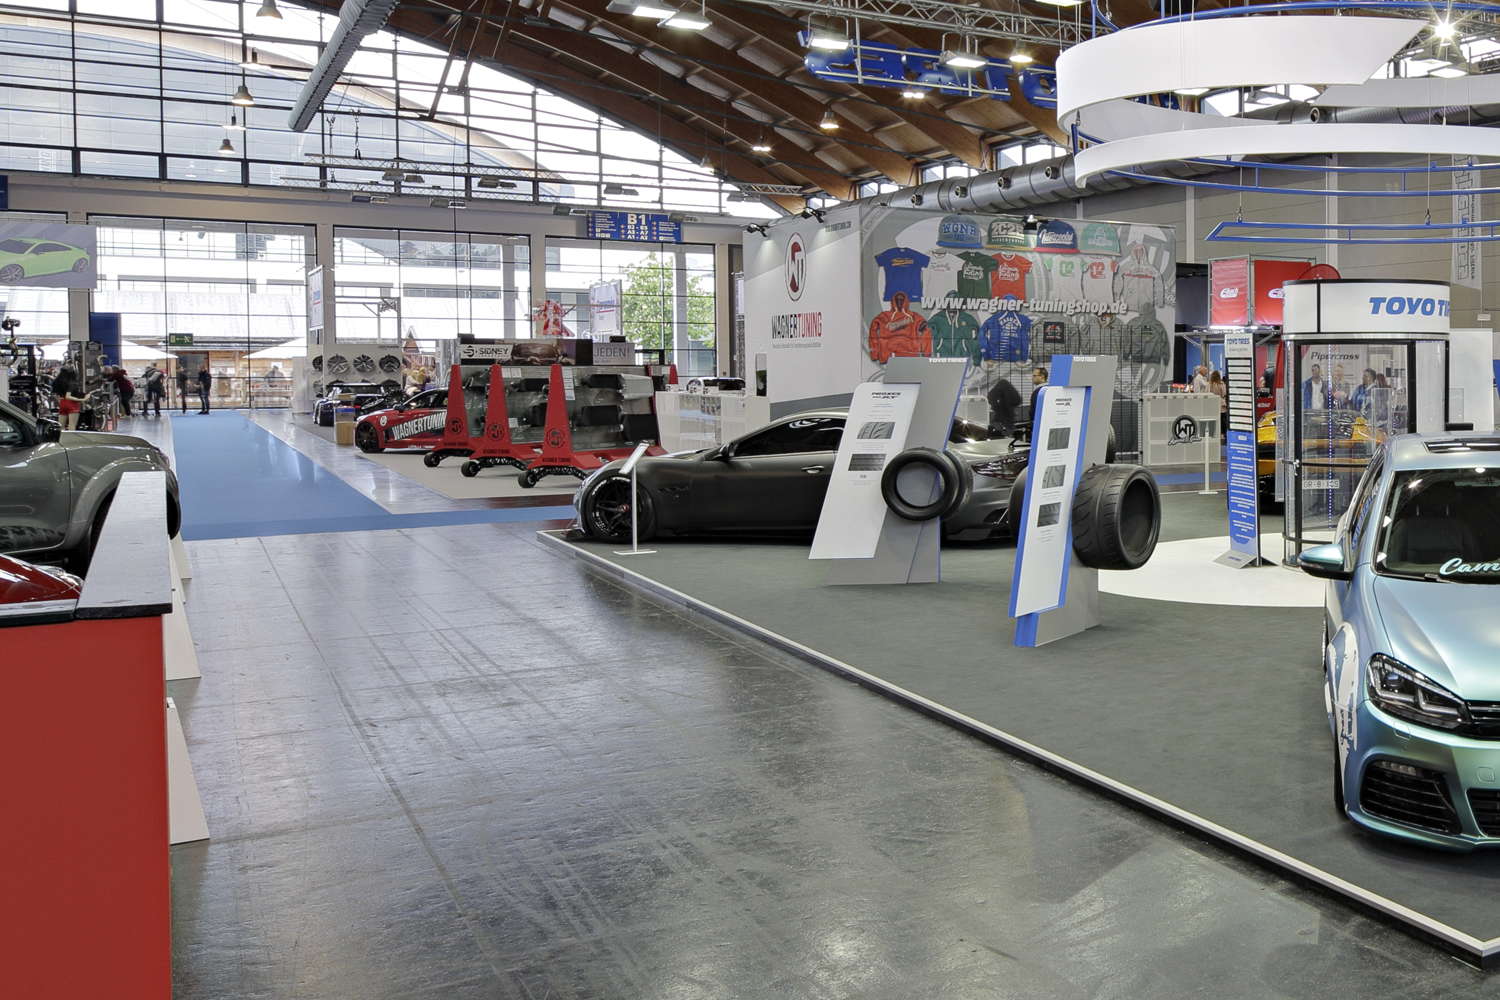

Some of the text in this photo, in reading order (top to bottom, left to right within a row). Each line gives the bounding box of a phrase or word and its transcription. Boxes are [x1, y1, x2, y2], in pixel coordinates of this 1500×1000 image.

[627, 213, 646, 226] B1
[921, 296, 1128, 315] www.wagner-tuningshop.de
[1369, 296, 1436, 316] TOYO
[479, 347, 508, 355] SIDNEY
[594, 347, 630, 358] JEDEN!
[391, 410, 447, 441] WAGNERTUNIN
